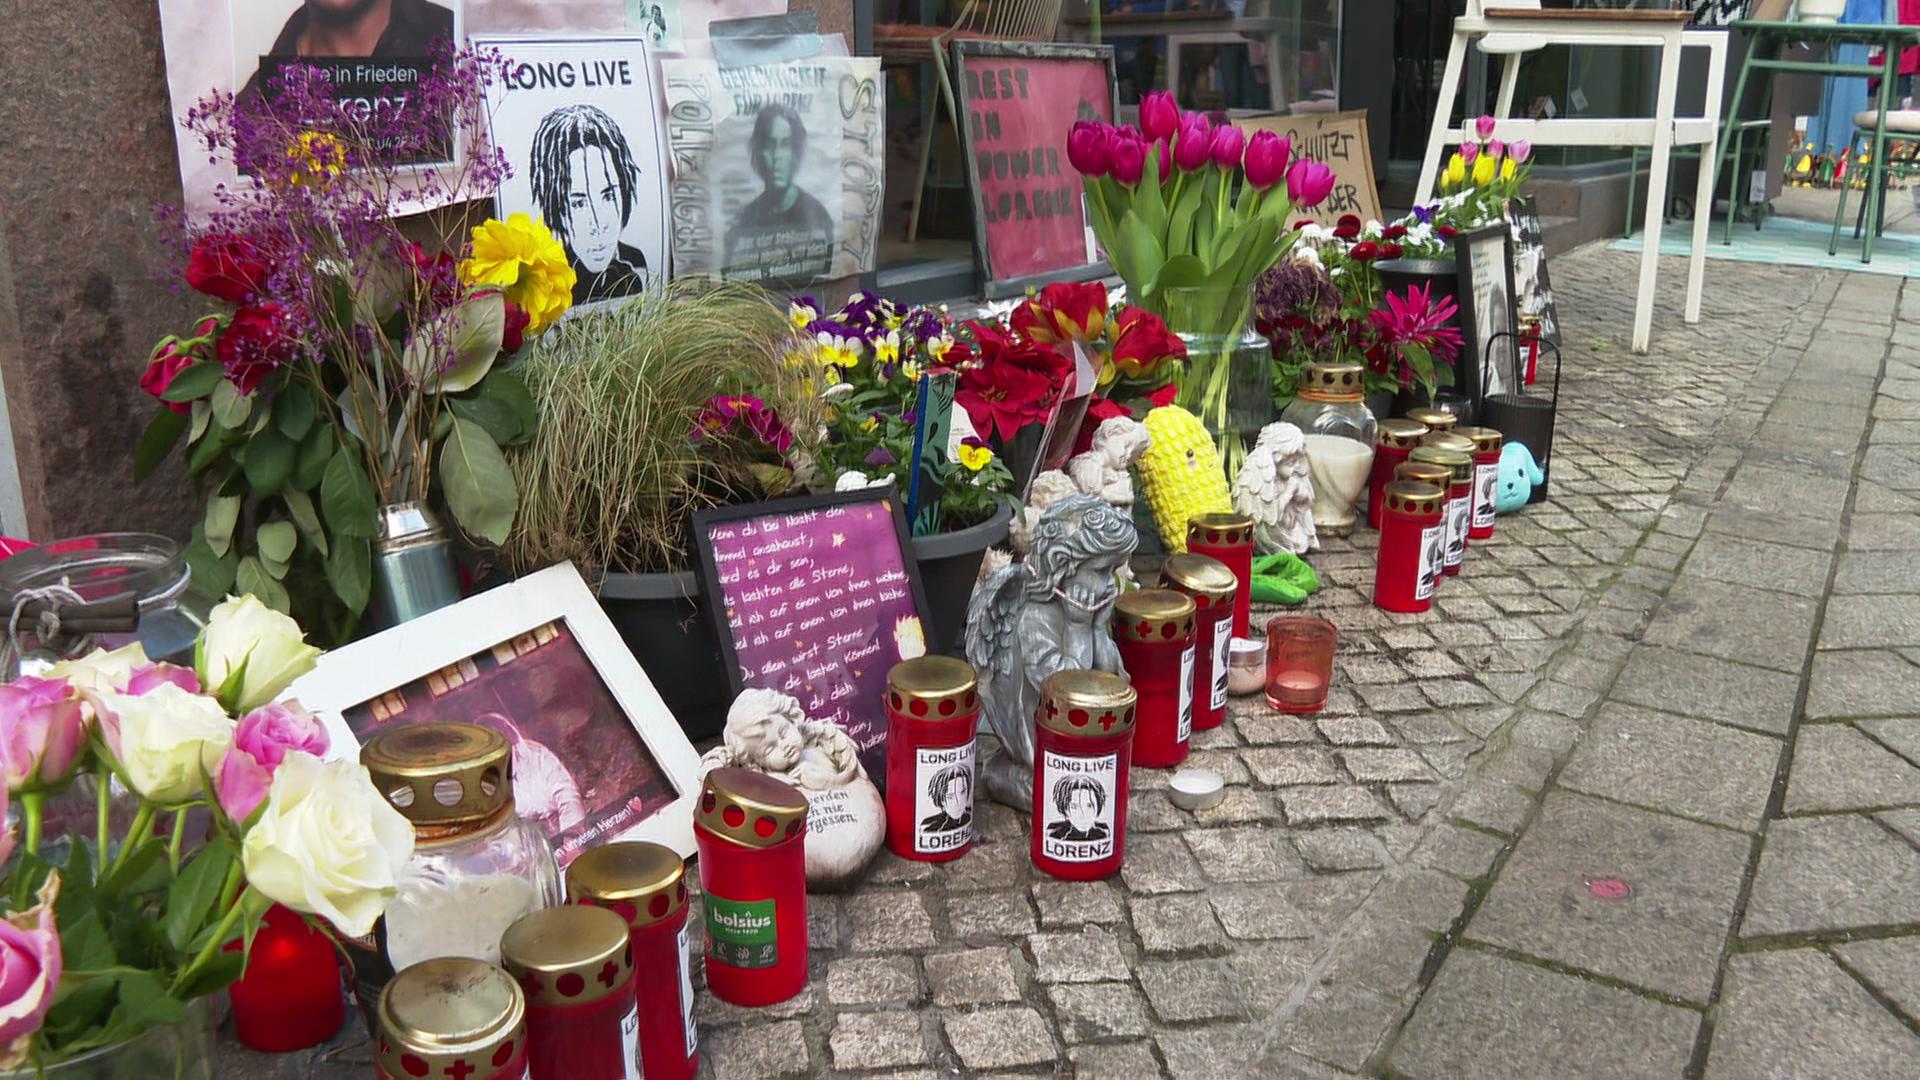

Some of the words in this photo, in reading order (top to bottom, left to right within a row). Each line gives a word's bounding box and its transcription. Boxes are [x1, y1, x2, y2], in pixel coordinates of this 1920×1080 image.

[336, 65, 351, 82] in
[356, 65, 418, 82] Frieden
[502, 61, 575, 89] LONG
[581, 60, 632, 86] LIVE
[965, 67, 1029, 100] REST
[971, 112, 1001, 141] IN
[978, 147, 1060, 182] POWER
[982, 187, 1075, 224] LORENZ
[742, 521, 757, 536] du
[825, 506, 845, 519] den
[825, 587, 844, 601] von
[830, 606, 848, 619] von
[810, 694, 824, 710] du
[920, 752, 957, 764] LONG
[1046, 757, 1081, 772] LONG
[1085, 757, 1115, 772] LIVE
[823, 805, 844, 815] nie
[807, 814, 858, 834] rgessen.
[919, 828, 971, 849] LOREN
[1045, 839, 1111, 858] LORENZ
[713, 905, 772, 929] bolsius
